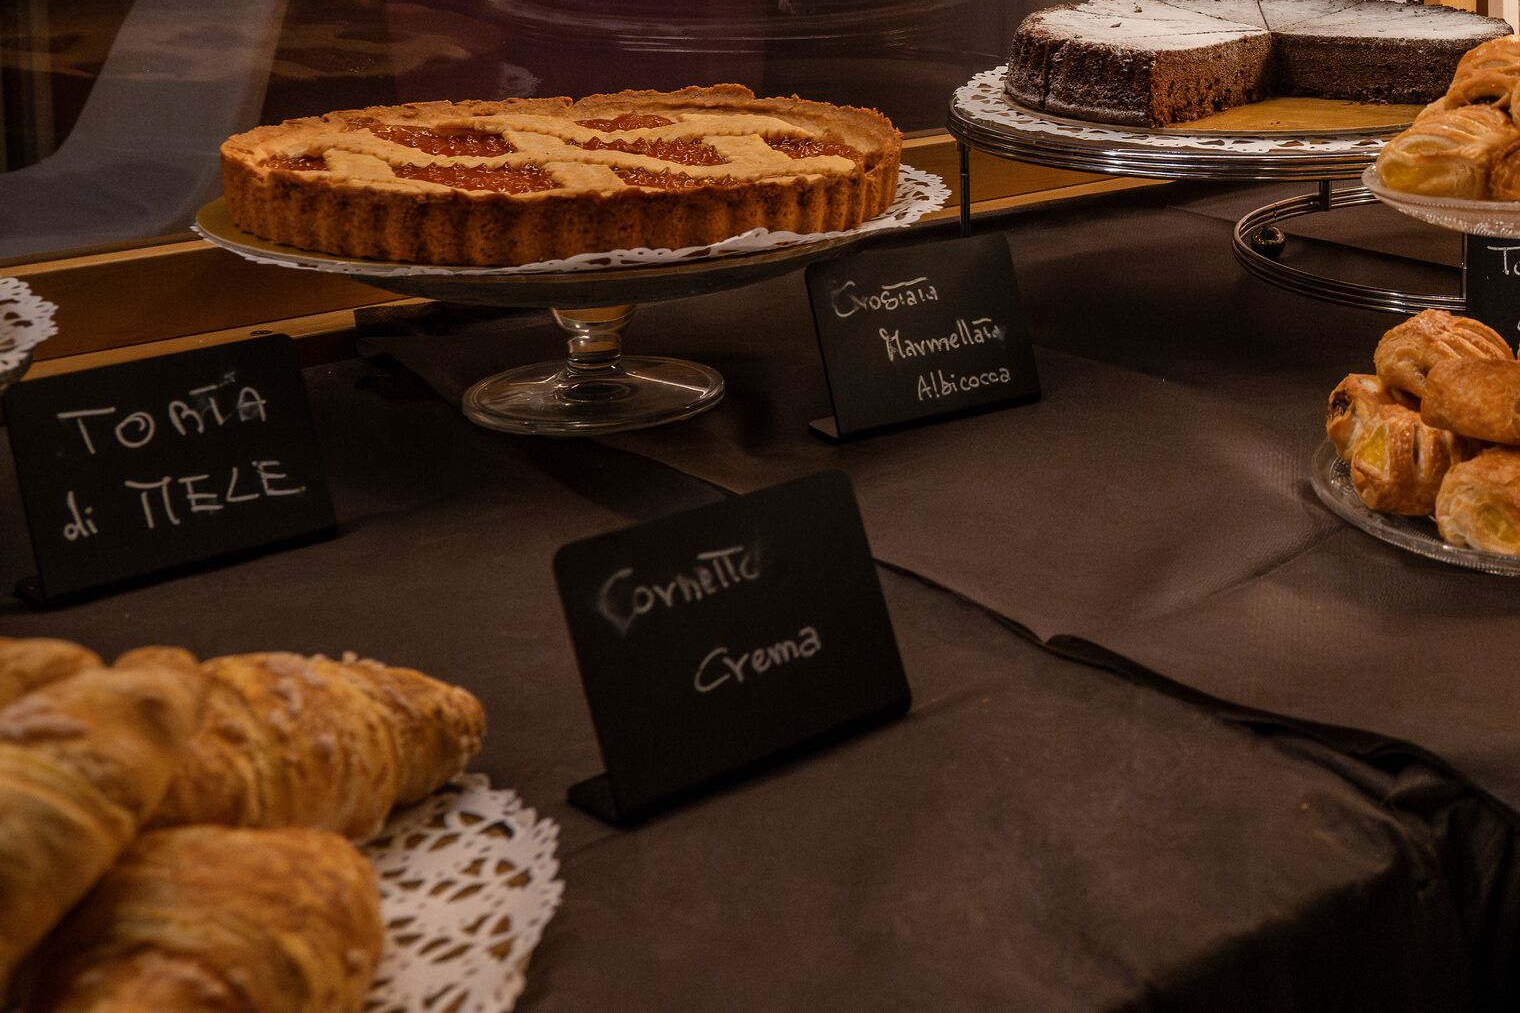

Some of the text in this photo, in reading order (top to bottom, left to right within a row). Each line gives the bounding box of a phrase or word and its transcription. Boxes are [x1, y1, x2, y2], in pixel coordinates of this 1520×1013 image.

[917, 368, 1011, 402] Albicocca
[63, 460, 306, 541] di MELE
[694, 625, 822, 694] Crema
